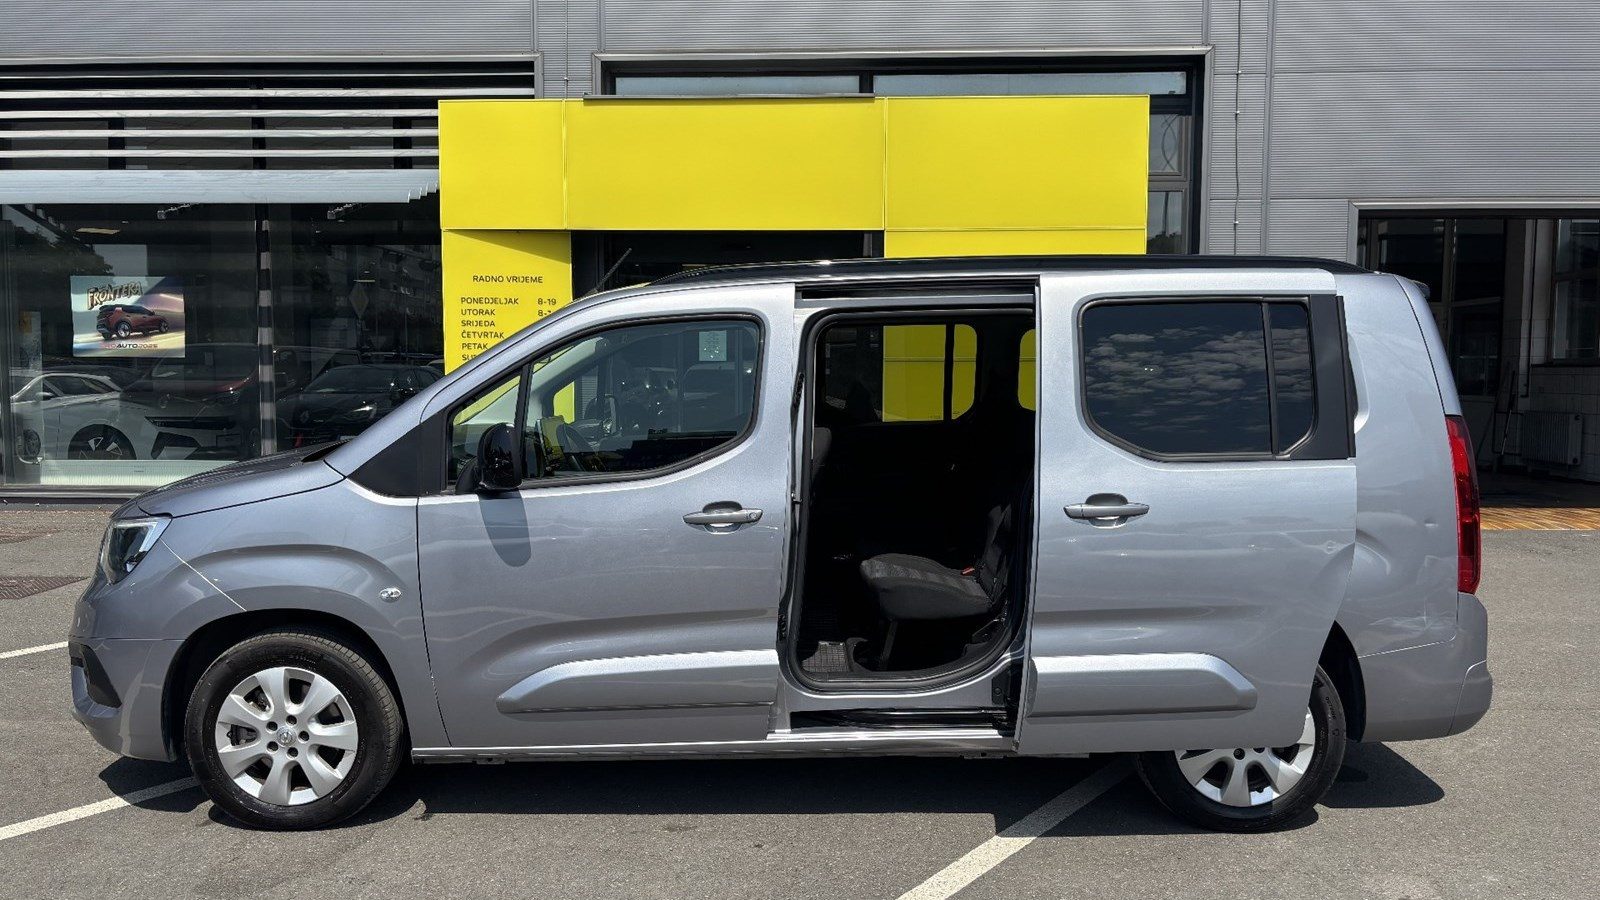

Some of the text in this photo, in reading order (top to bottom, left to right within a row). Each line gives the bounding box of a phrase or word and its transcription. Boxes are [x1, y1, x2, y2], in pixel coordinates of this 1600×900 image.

[472, 275, 544, 284] RADNO VRIJEME
[87, 281, 144, 310] FRONTERA
[460, 296, 557, 306] PONEDJELJAK 8-19
[460, 308, 496, 316] UTORAK
[461, 330, 505, 339] ČETVRTAK
[461, 342, 489, 350] PETAK
